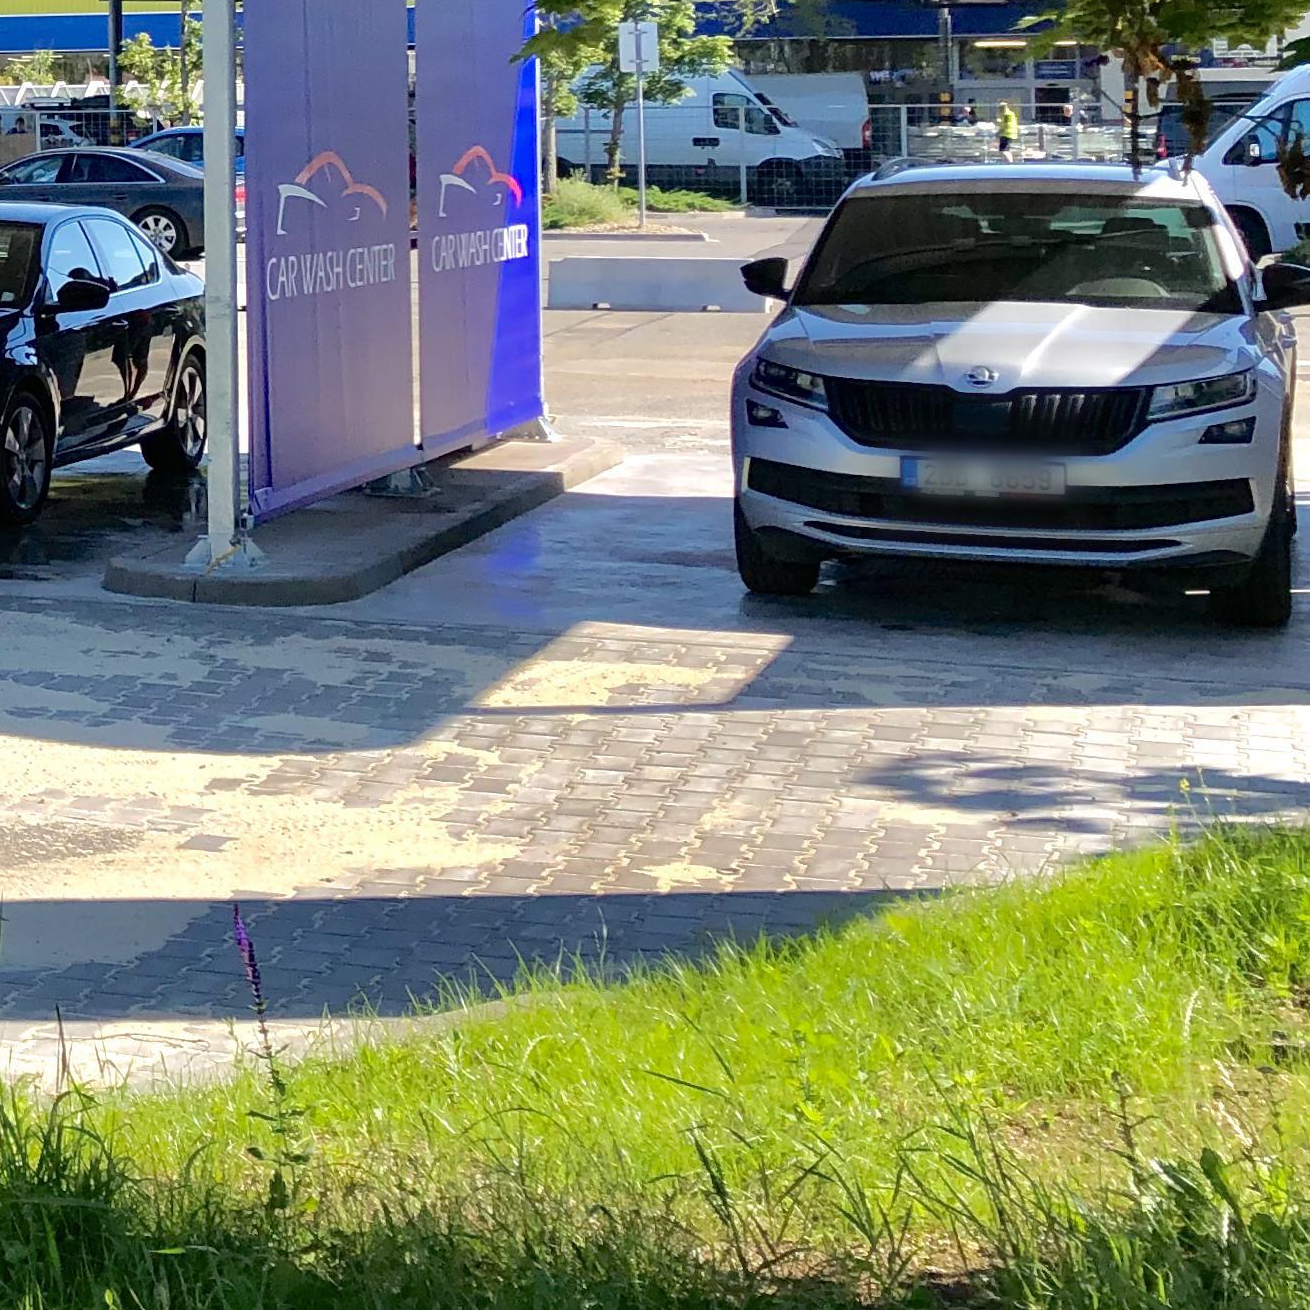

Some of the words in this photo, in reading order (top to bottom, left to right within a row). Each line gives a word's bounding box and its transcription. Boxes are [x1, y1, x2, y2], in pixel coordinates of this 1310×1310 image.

[266, 255, 298, 300] CAR
[300, 251, 344, 295] WASH
[346, 243, 397, 288] CENTER
[431, 234, 456, 272] CAR
[456, 230, 490, 268] WASH
[491, 223, 528, 262] CENTER
